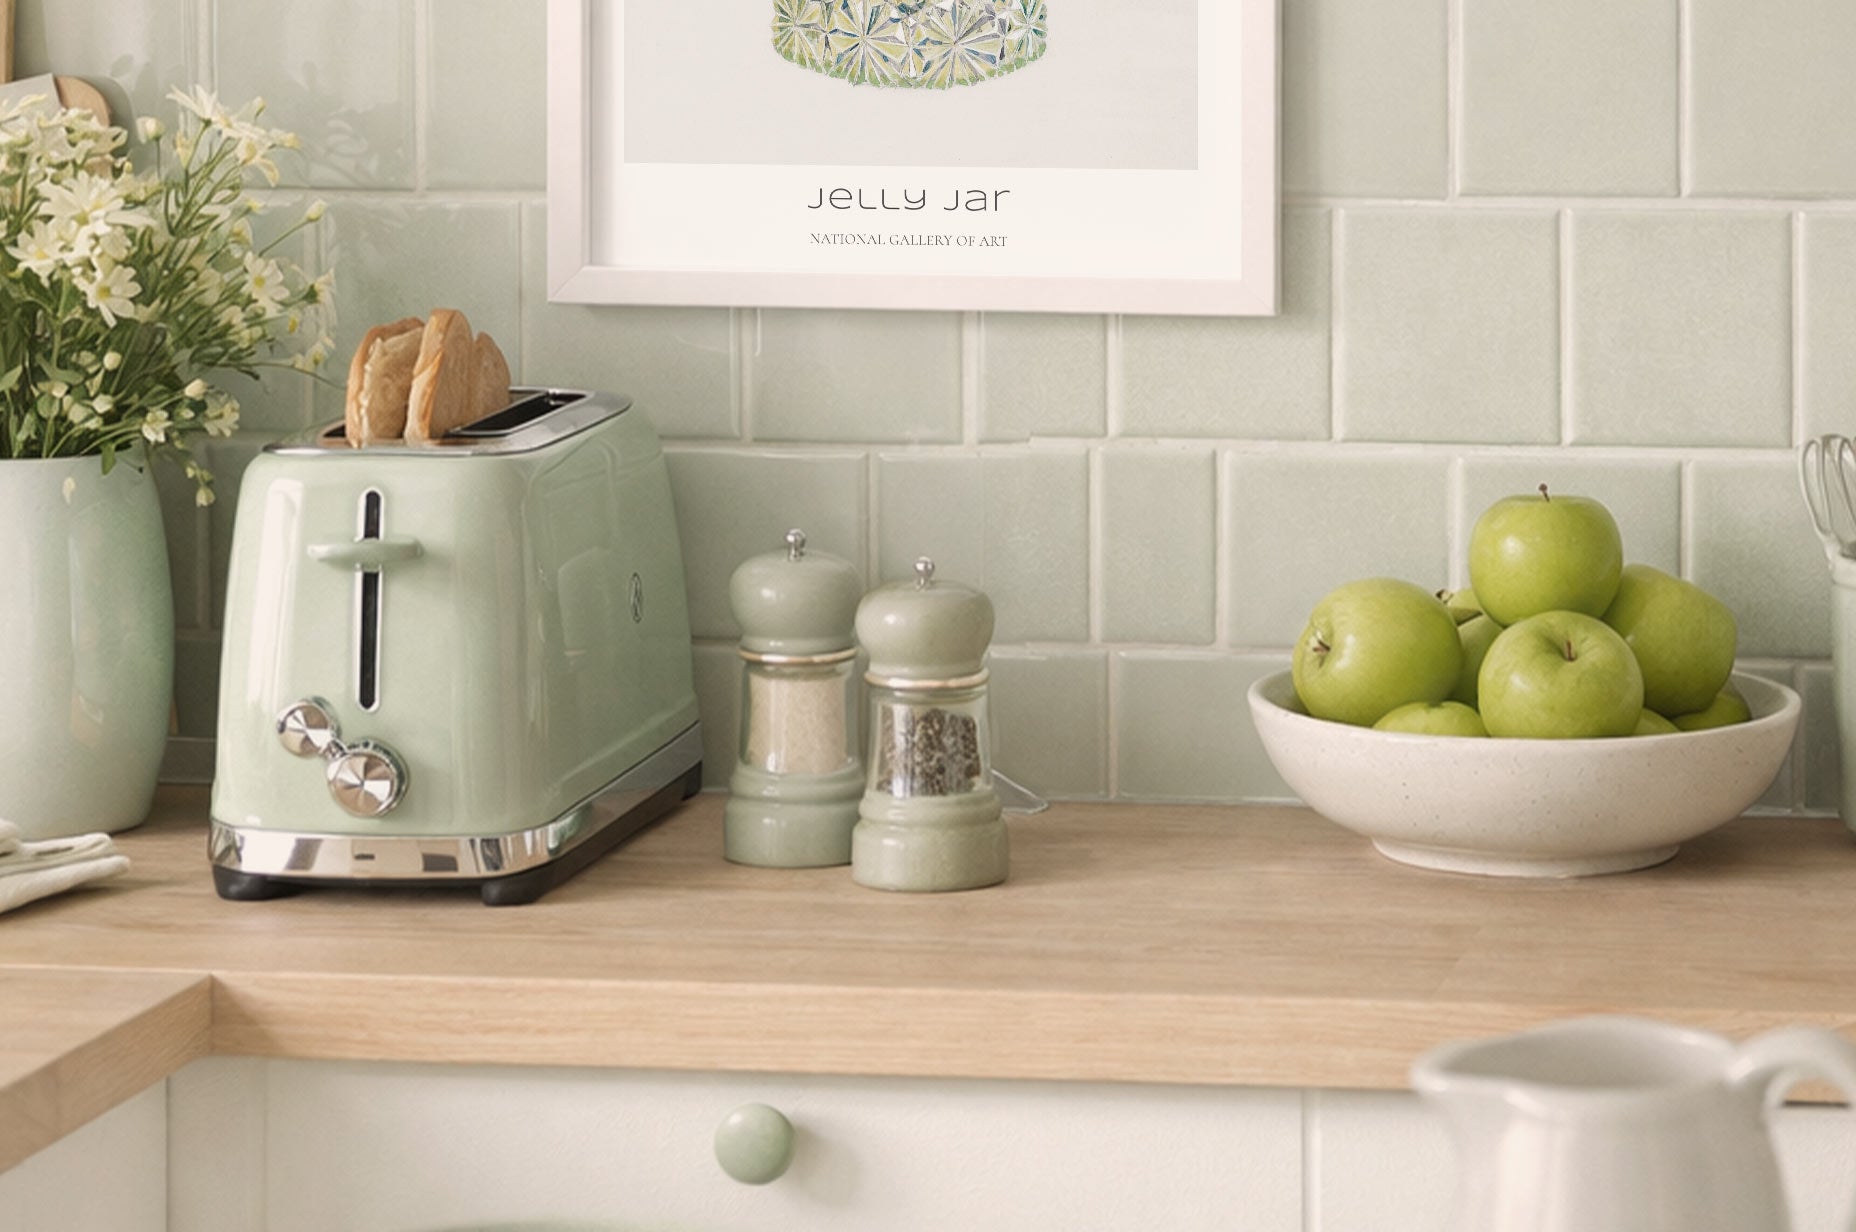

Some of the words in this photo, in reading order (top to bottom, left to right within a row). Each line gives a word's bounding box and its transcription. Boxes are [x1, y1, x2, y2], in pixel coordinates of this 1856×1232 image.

[810, 233, 886, 246] NATIONAL
[889, 234, 952, 247] GALLERY
[956, 235, 976, 247] OF
[979, 235, 1008, 248] ART
